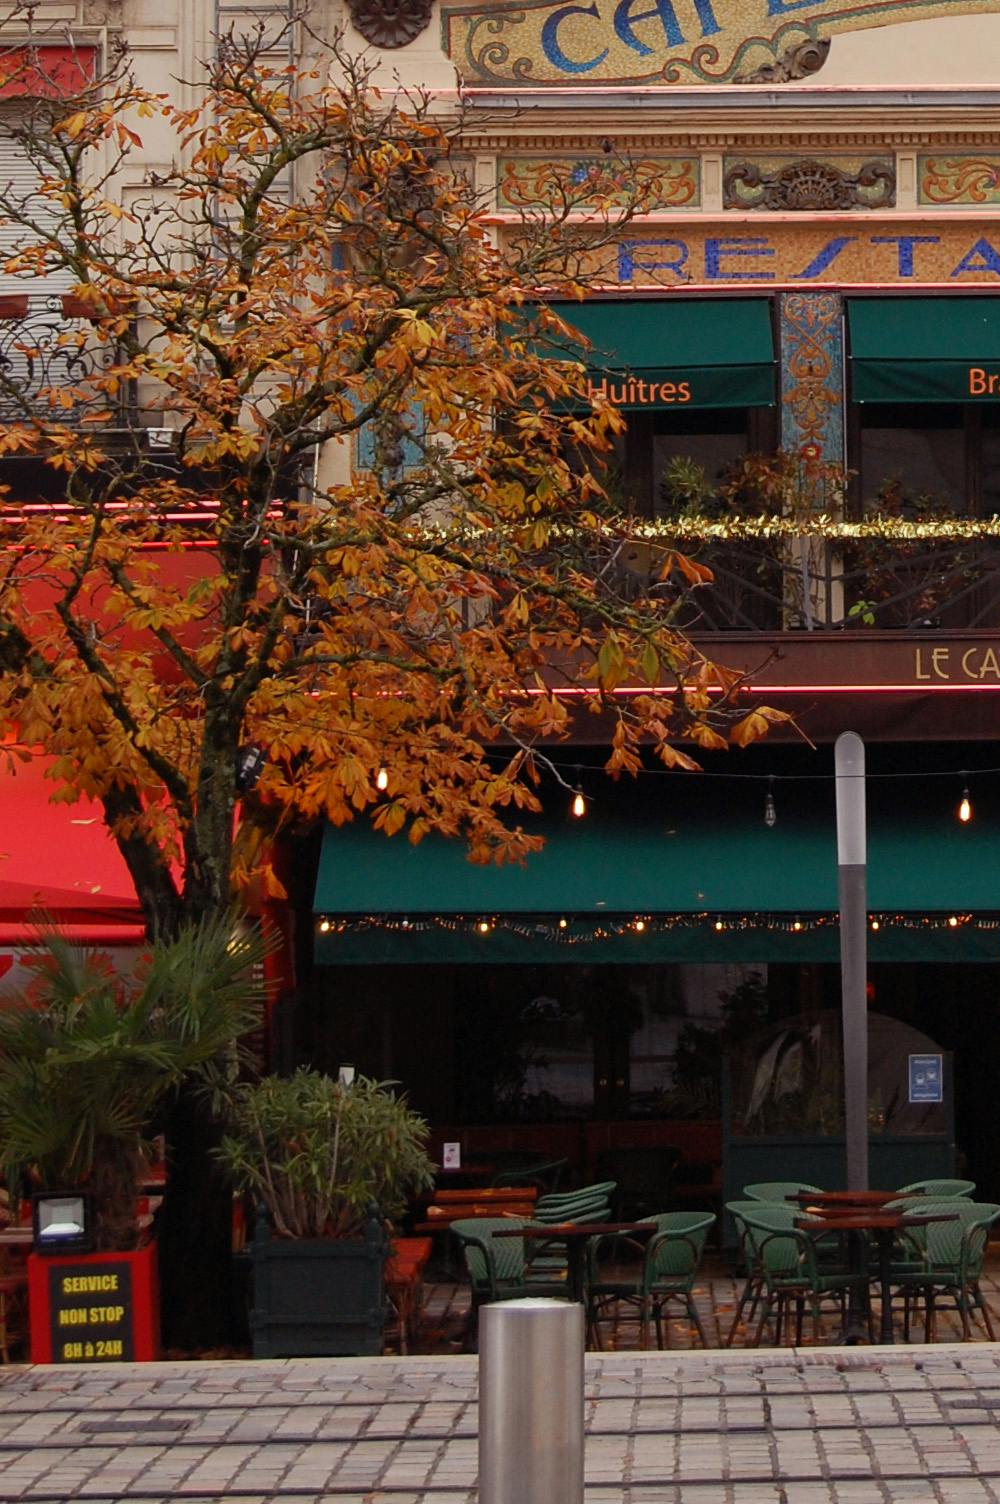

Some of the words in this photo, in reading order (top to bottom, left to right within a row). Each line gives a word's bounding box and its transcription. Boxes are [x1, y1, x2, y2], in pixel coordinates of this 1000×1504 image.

[587, 377, 692, 404] Huîtres
[915, 648, 950, 680] LE
[63, 1274, 119, 1293] SERVICE
[60, 1308, 88, 1325] NON
[89, 1306, 124, 1323] STOP
[64, 1342, 82, 1358] 8H
[96, 1339, 122, 1356] 24H
